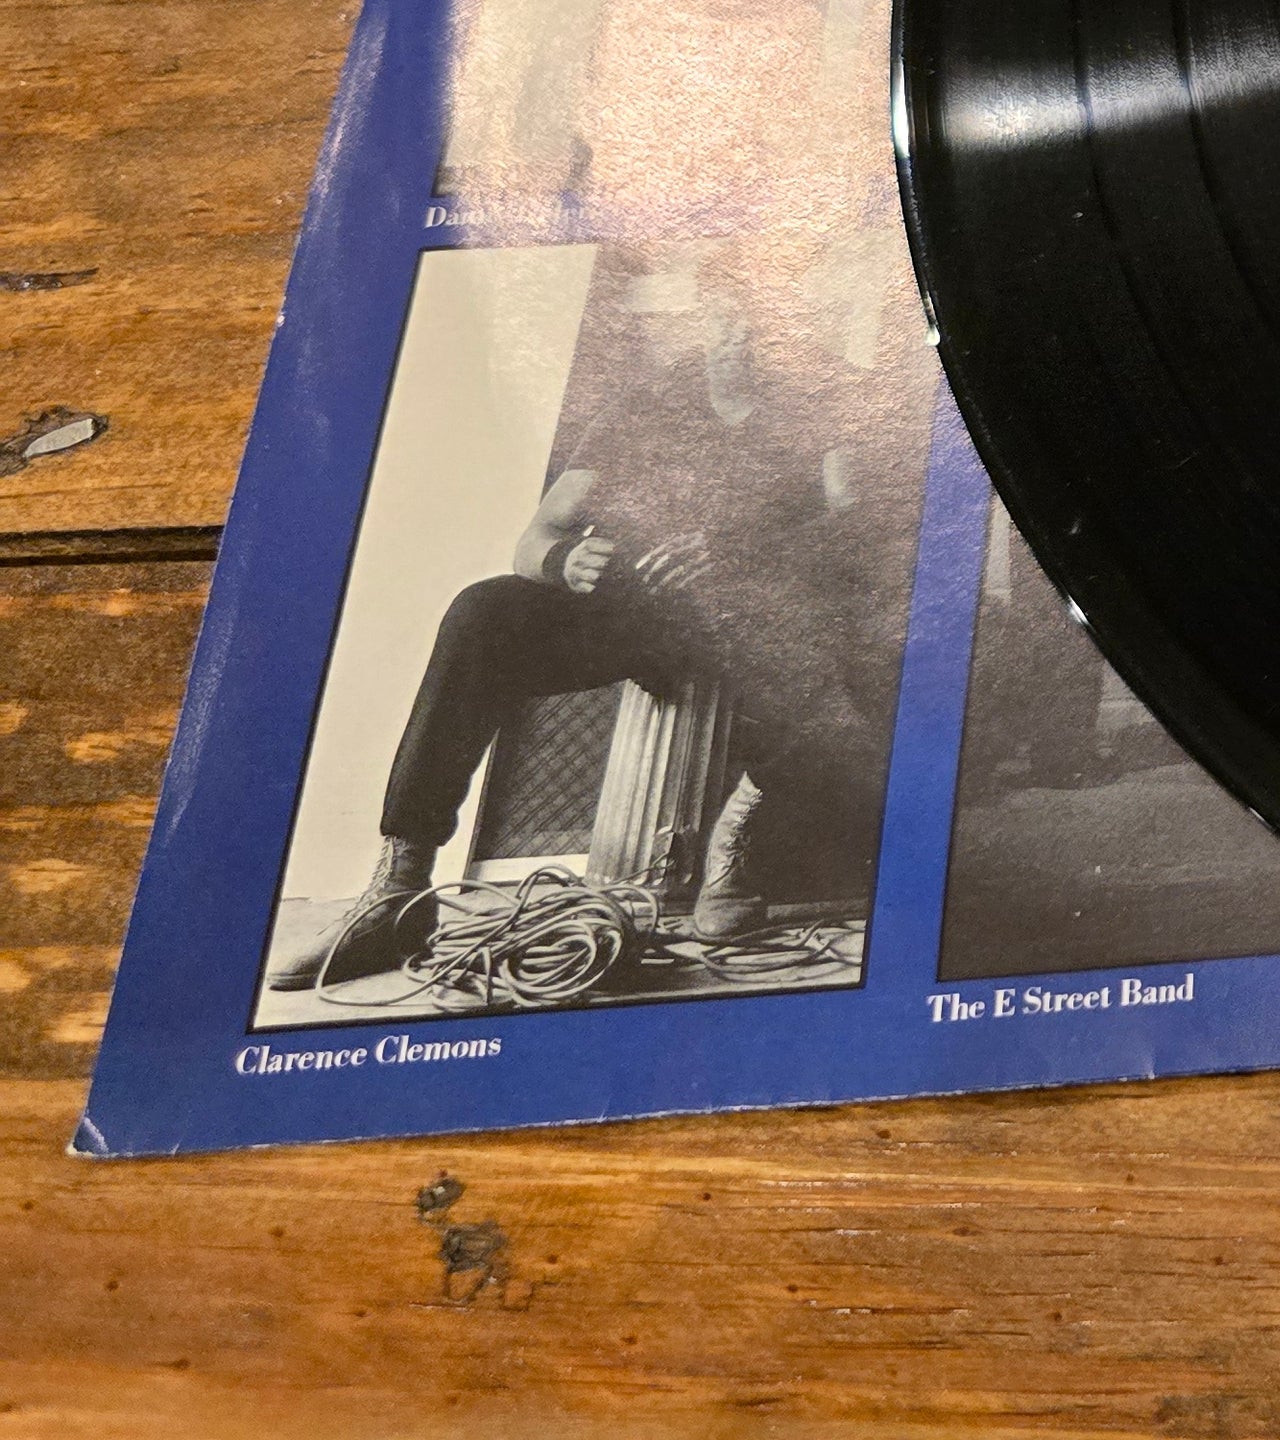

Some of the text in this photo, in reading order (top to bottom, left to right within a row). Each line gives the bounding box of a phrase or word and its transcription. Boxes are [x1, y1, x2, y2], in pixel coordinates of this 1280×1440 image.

[926, 972, 1195, 1022] The E Street Band
[235, 1035, 502, 1075] Clarence Clemons
